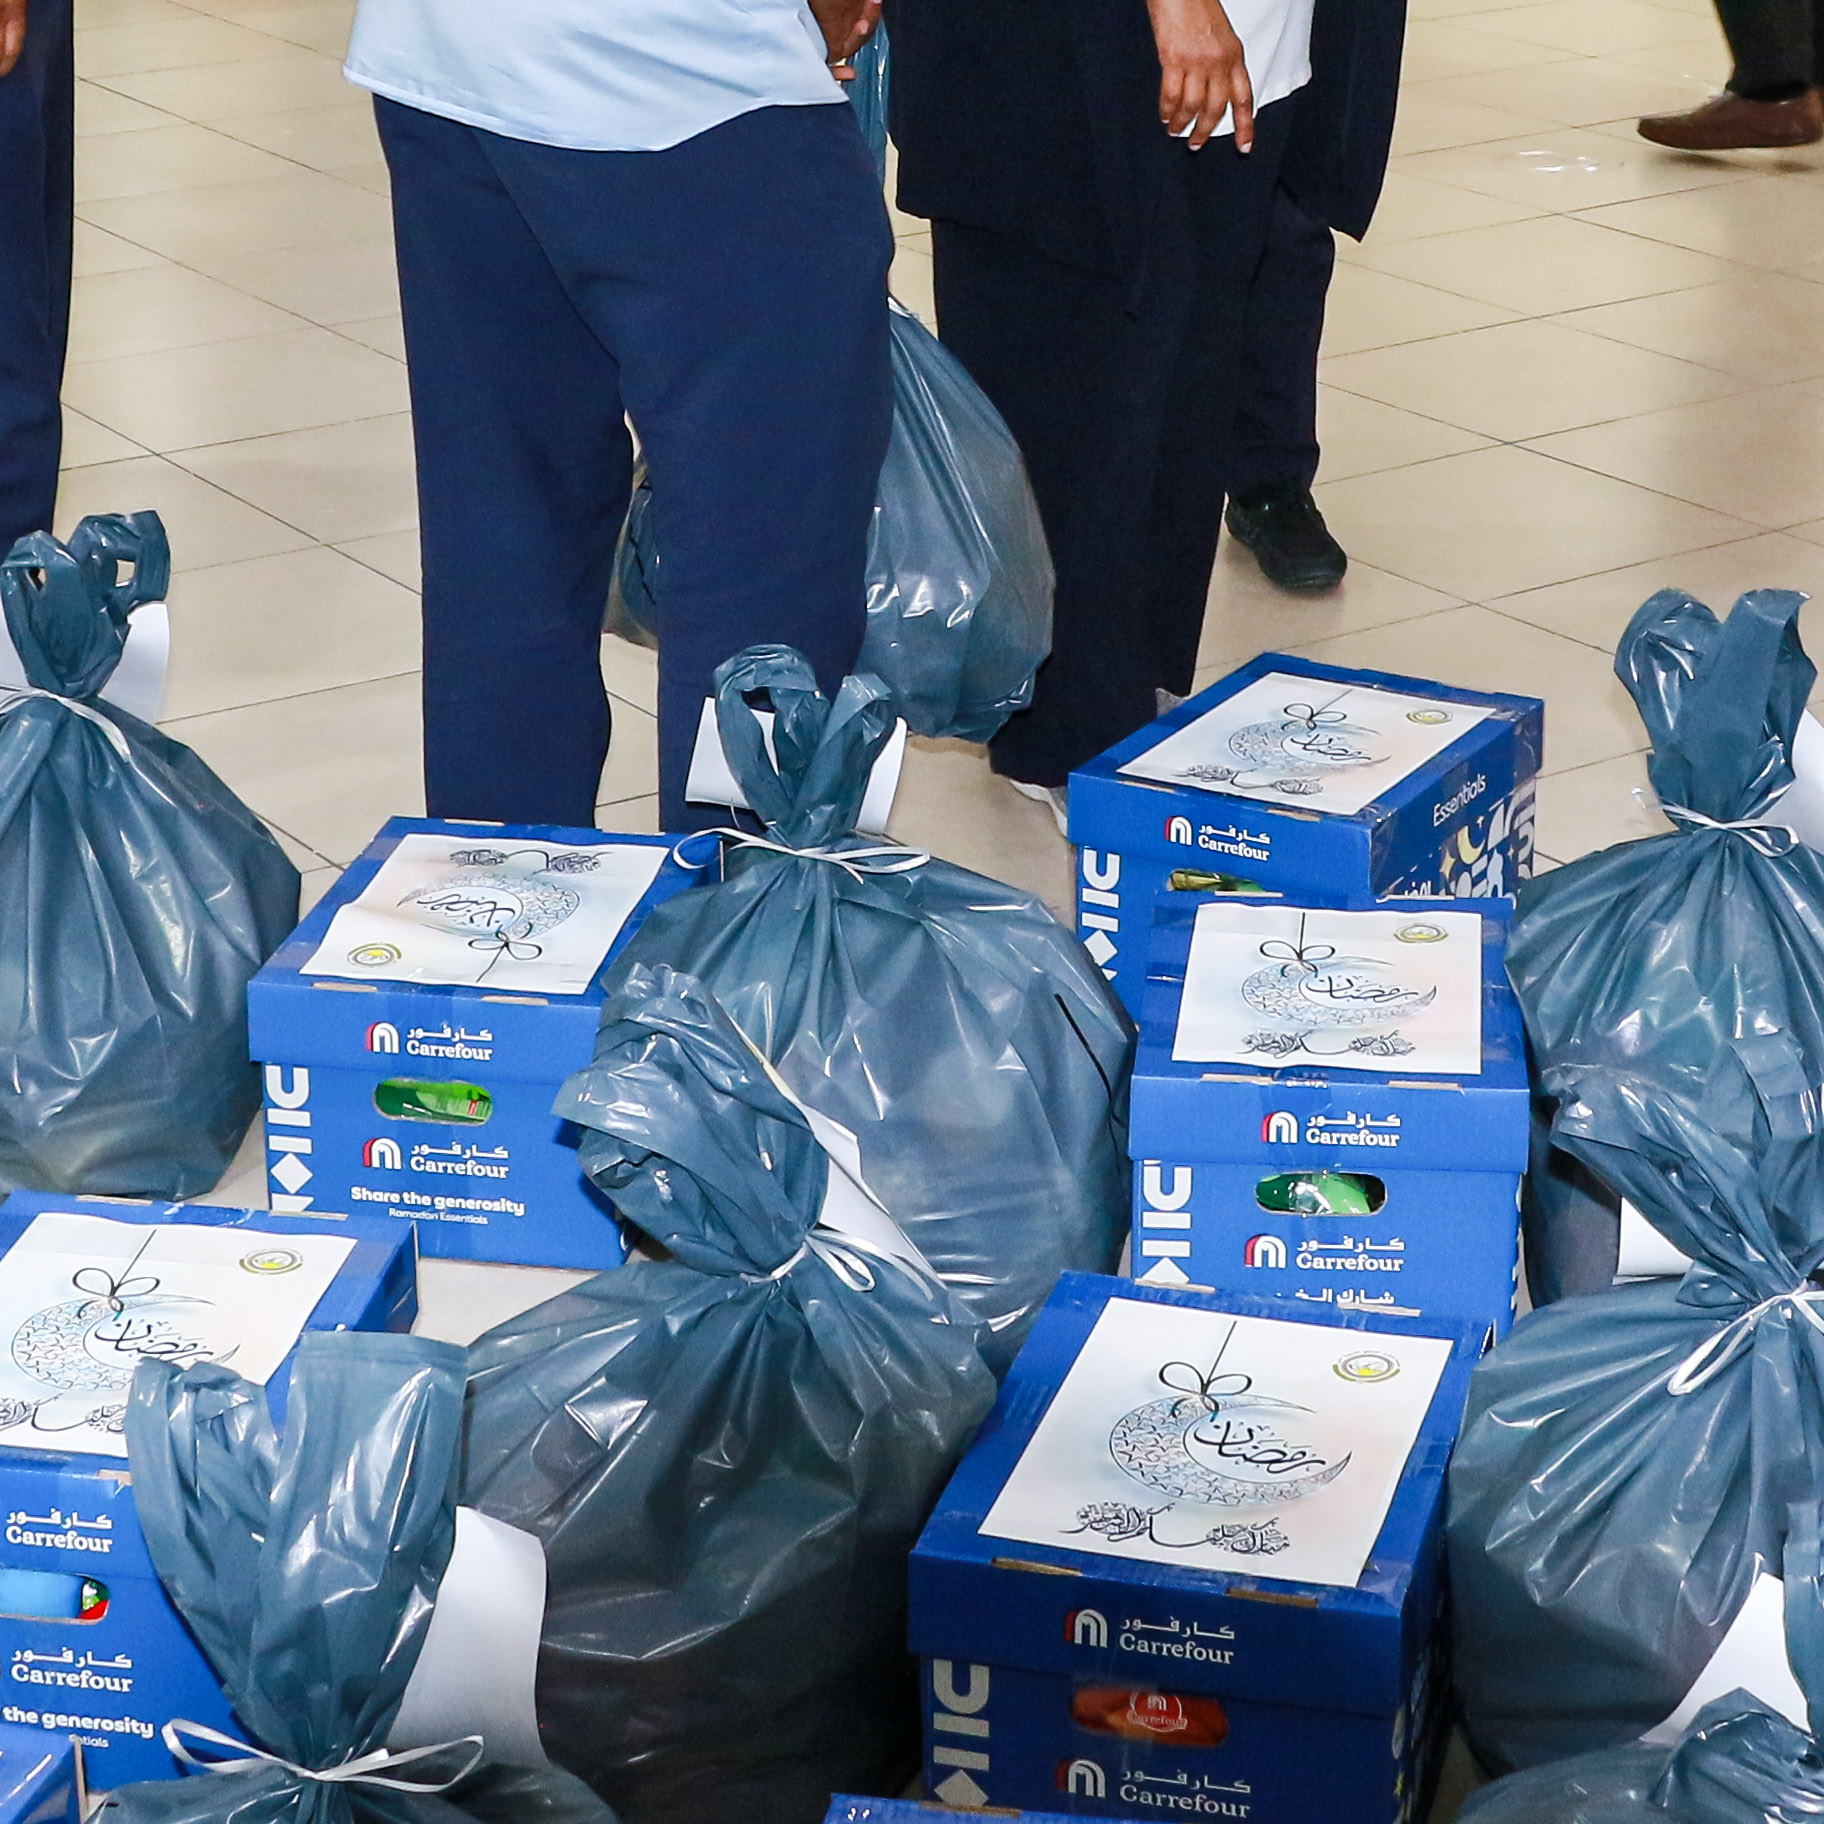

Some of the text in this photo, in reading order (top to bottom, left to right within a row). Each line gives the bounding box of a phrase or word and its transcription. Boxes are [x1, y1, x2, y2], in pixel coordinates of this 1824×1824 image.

[1434, 773, 1486, 826] Essentials
[1199, 823, 1271, 844] كارفور
[1198, 834, 1270, 862] Carrefour
[407, 1024, 493, 1042] كارفور
[406, 1040, 494, 1061] Carrefour
[1307, 1110, 1402, 1128] كارفور
[1306, 1128, 1400, 1147] Carrefour
[411, 1141, 510, 1159] كارفور
[410, 1156, 510, 1179] Carrefour
[351, 1186, 526, 1217] Share the generosity
[388, 1207, 489, 1225] Ramadan Essentials
[1296, 1235, 1405, 1253] كارفور
[1296, 1253, 1405, 1272] Carrefour
[5, 1507, 113, 1529] كارفور
[5, 1525, 113, 1553] Carrefour
[1121, 1616, 1236, 1640] كارفور
[11, 1647, 133, 1669] كارفور
[1119, 1633, 1235, 1665] Carrefour
[10, 1664, 134, 1693] Carrefour
[2, 1706, 39, 1724] the
[41, 1712, 155, 1739] generosity
[1127, 1710, 1188, 1730] Carrefour
[1121, 1768, 1252, 1794] كارفور
[1119, 1783, 1252, 1819] Carrefour
